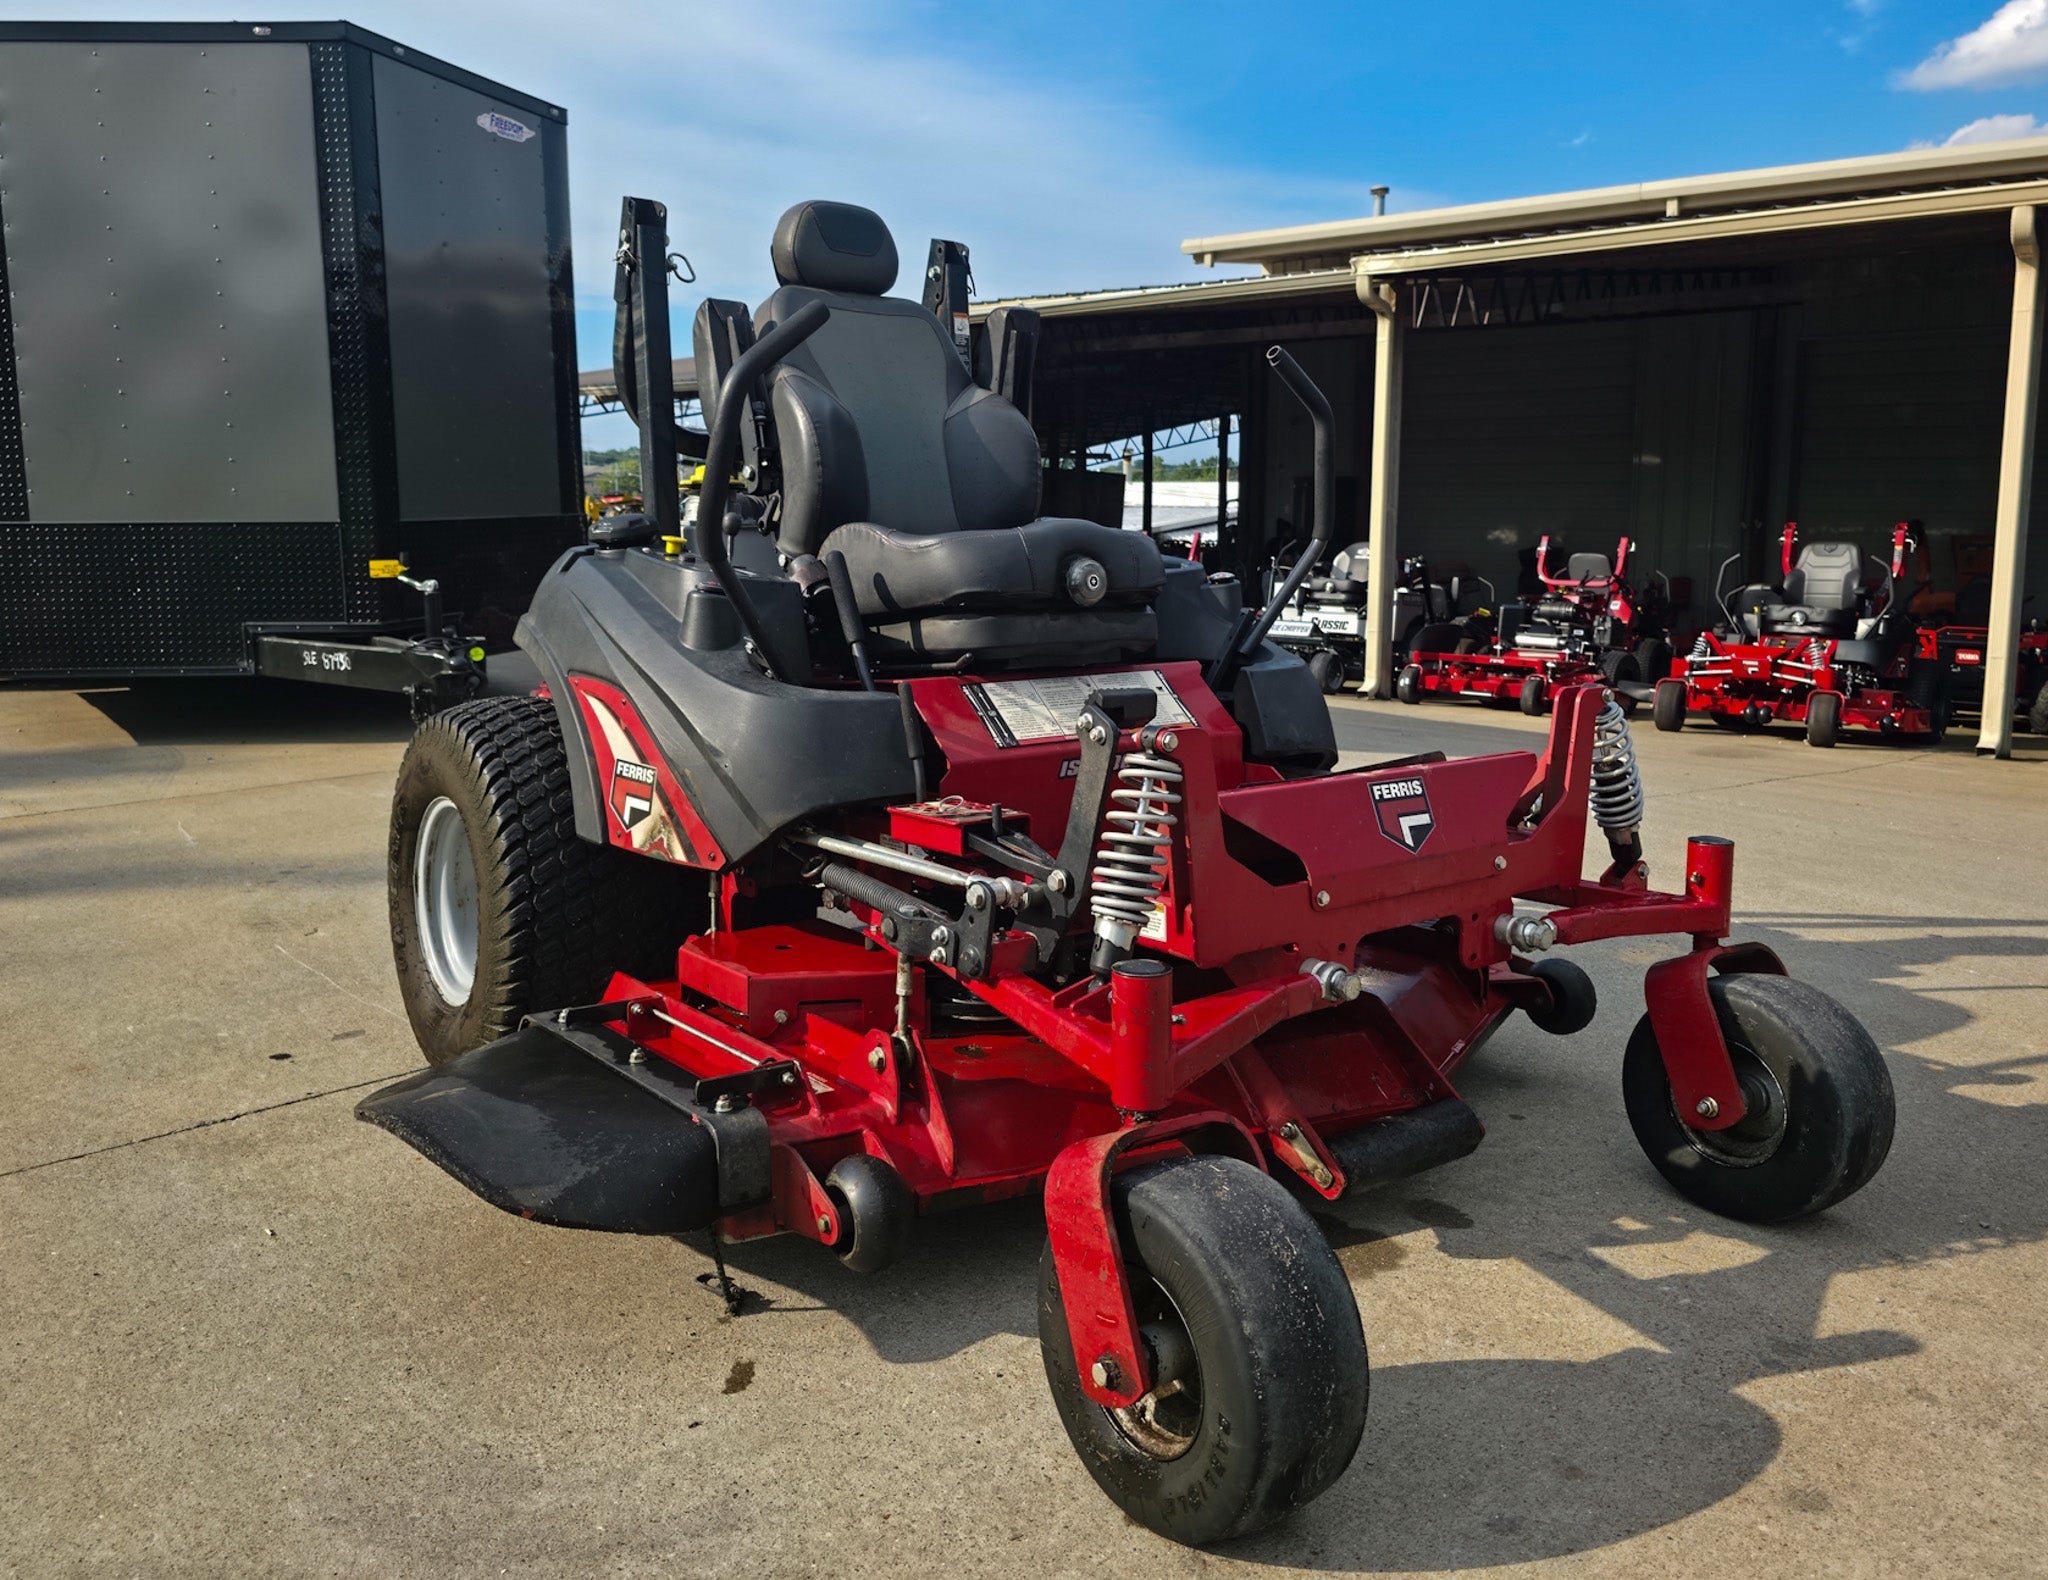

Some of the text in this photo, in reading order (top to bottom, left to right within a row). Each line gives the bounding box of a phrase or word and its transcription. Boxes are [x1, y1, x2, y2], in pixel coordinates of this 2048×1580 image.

[490, 113, 524, 136] FREEDOM
[616, 760, 655, 784] FERRIS
[1372, 779, 1423, 800] FERRIS
